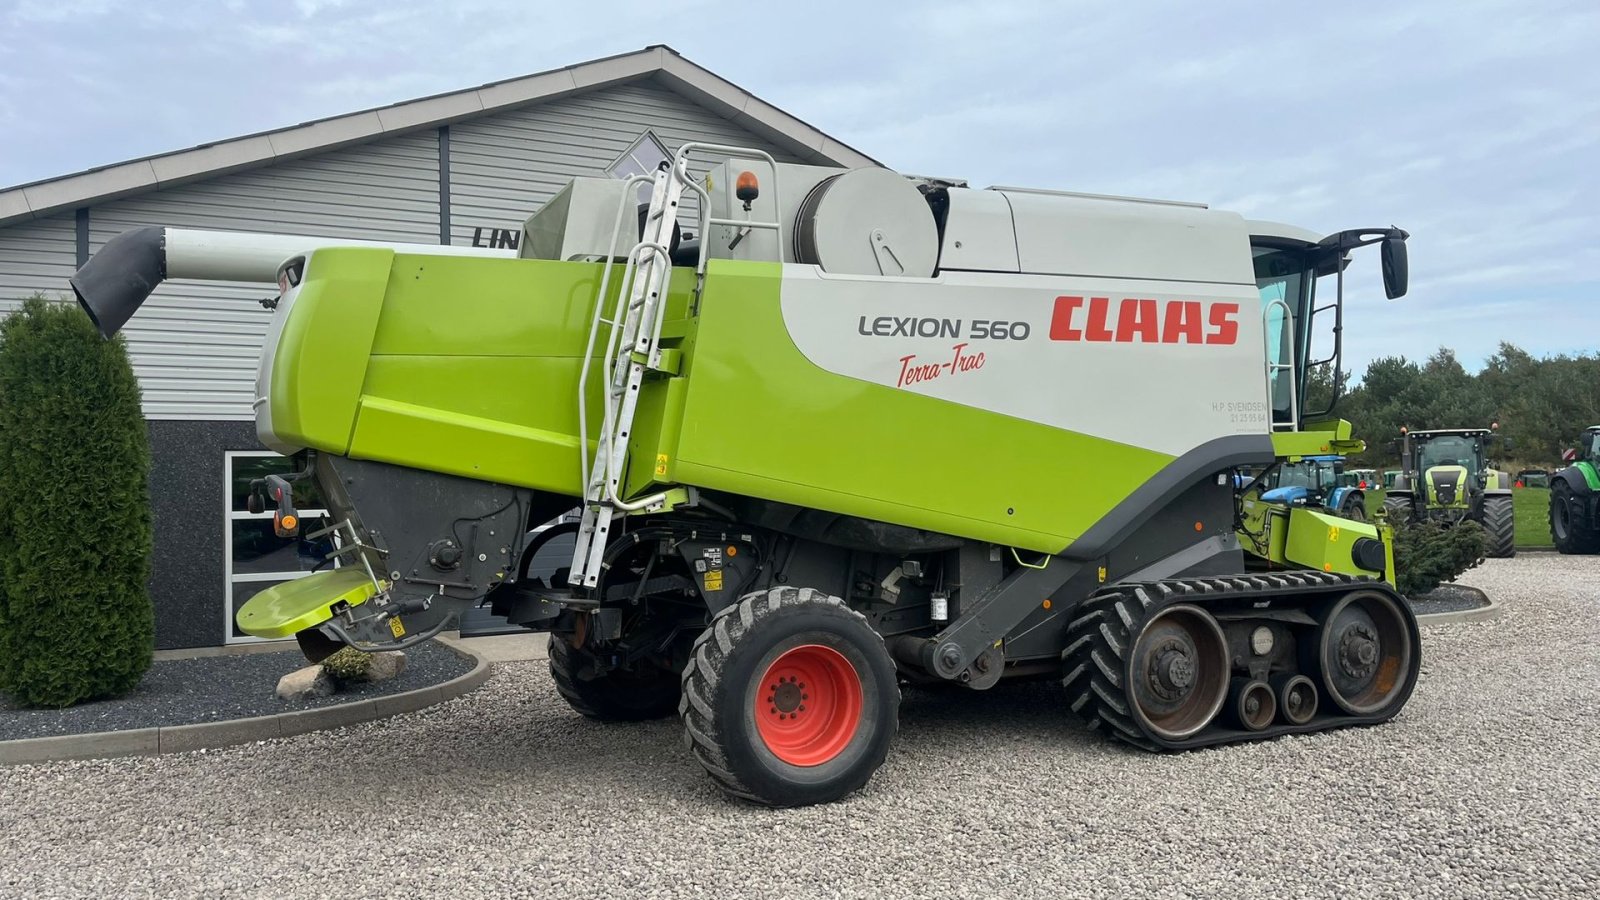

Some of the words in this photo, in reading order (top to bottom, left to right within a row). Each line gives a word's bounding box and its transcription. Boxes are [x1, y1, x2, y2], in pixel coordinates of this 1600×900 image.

[472, 227, 521, 250] LIN
[858, 315, 962, 339] LEXION
[969, 320, 1031, 341] 560
[1049, 296, 1239, 345] CLAAS
[897, 343, 986, 388] Terra-Trac
